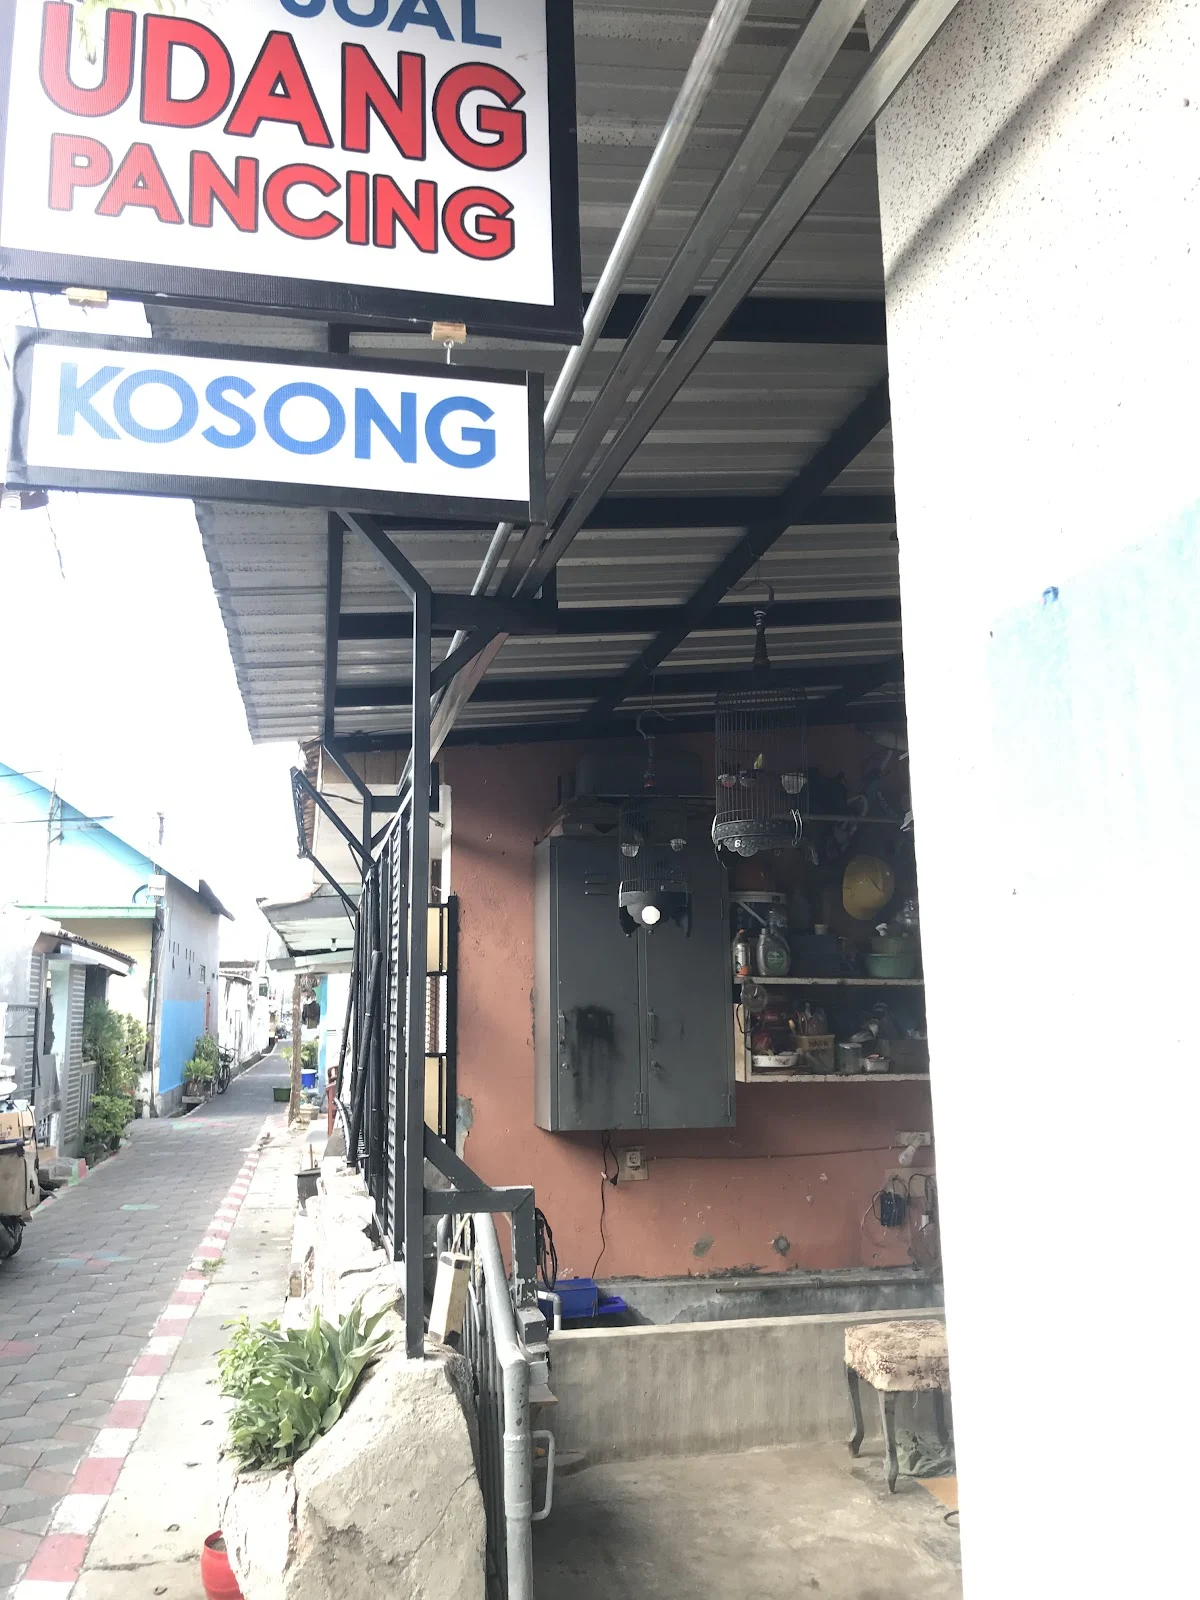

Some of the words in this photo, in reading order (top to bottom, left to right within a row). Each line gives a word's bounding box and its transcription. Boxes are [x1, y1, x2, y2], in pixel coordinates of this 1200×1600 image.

[39, 1, 527, 172] UDANG
[47, 132, 515, 261] PANCING
[56, 361, 497, 470] KOSONG
